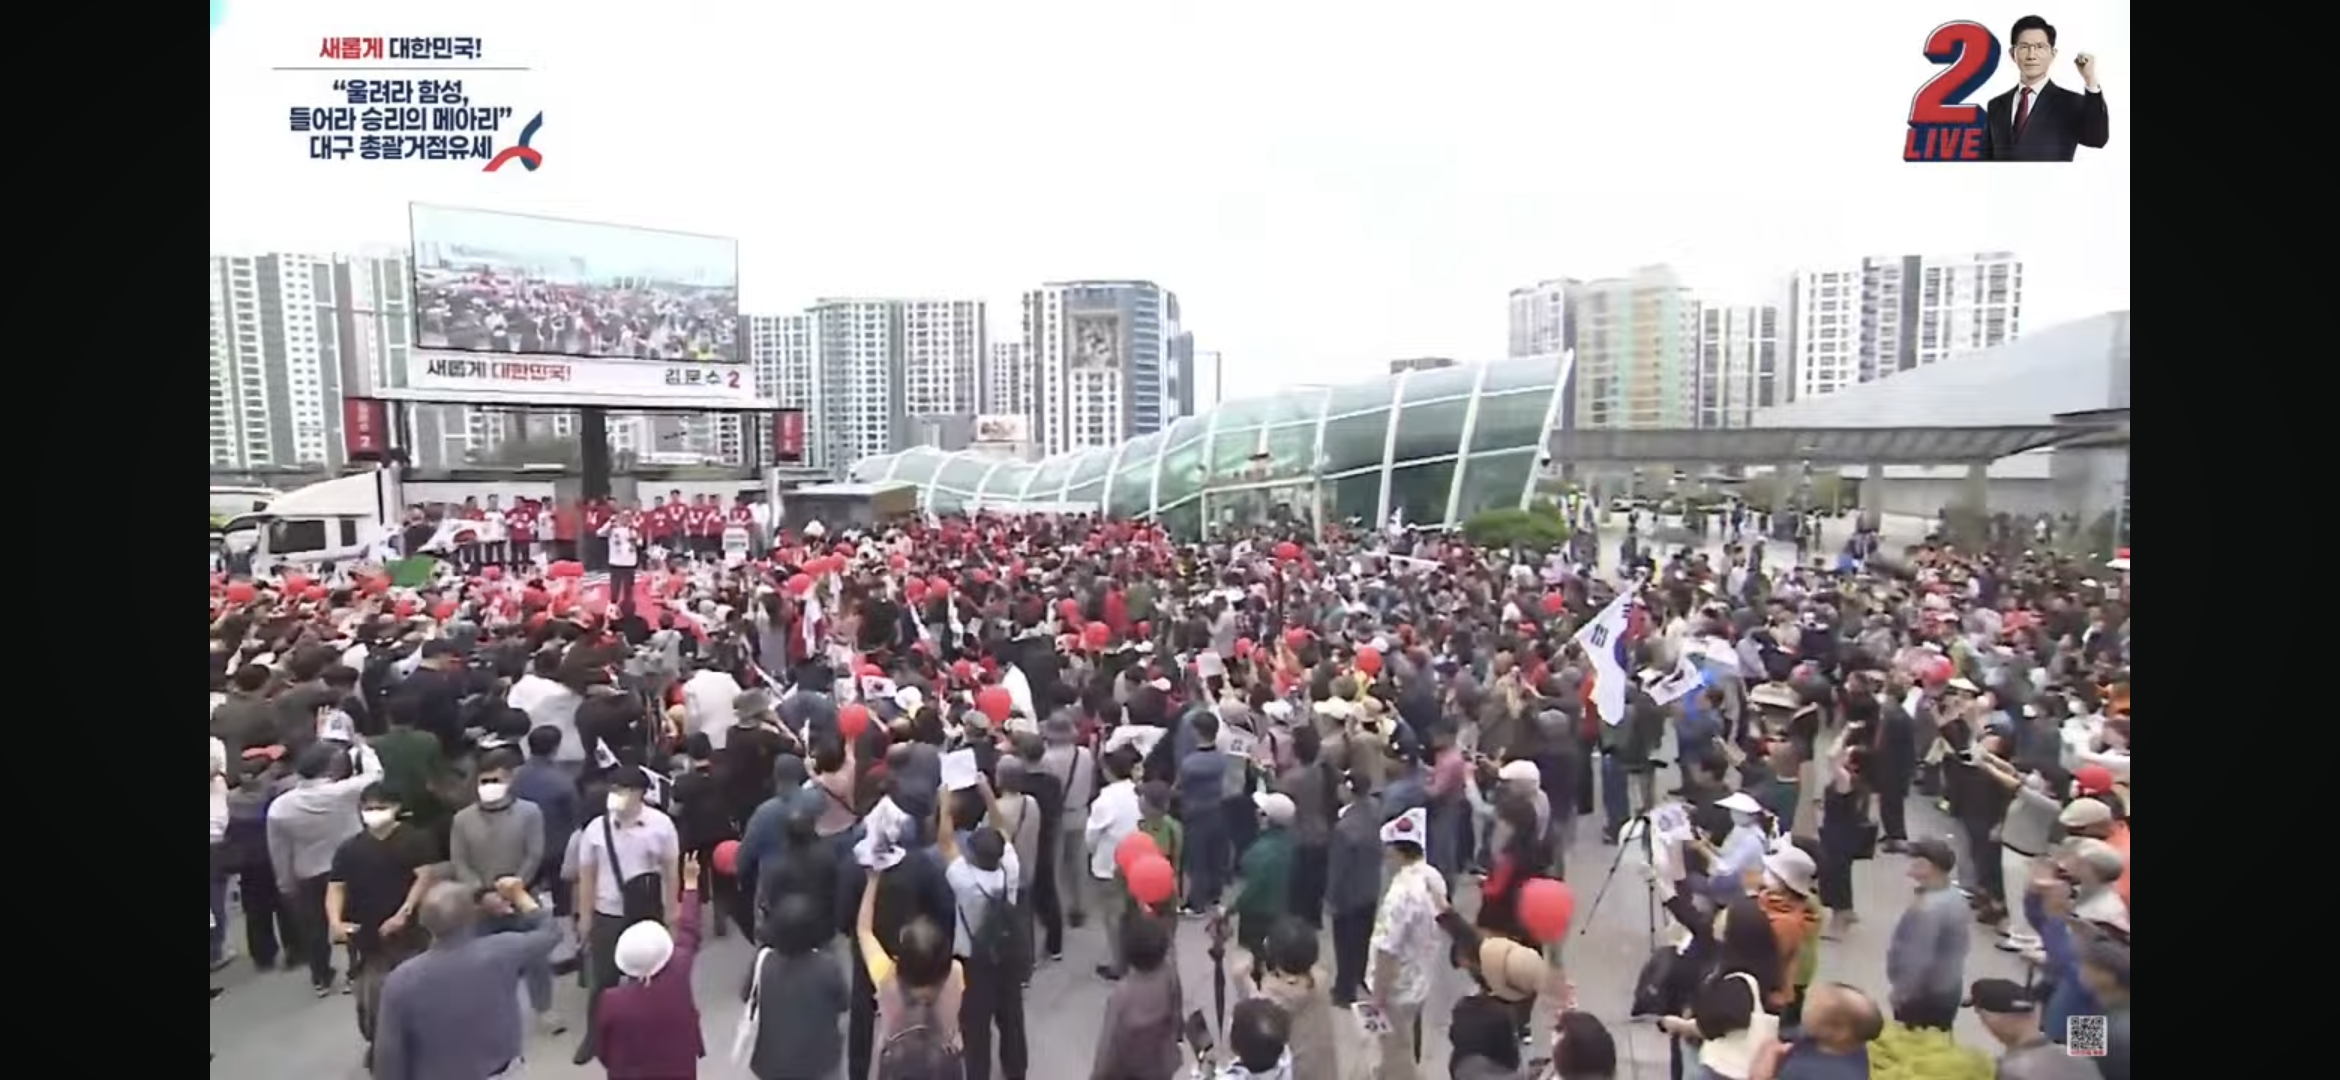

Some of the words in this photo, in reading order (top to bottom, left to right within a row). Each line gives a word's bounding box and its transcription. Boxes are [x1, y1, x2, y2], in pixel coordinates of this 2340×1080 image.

[426, 359, 487, 379] 새롭게
[491, 361, 571, 382] 대한민국!
[727, 370, 740, 389] 2
